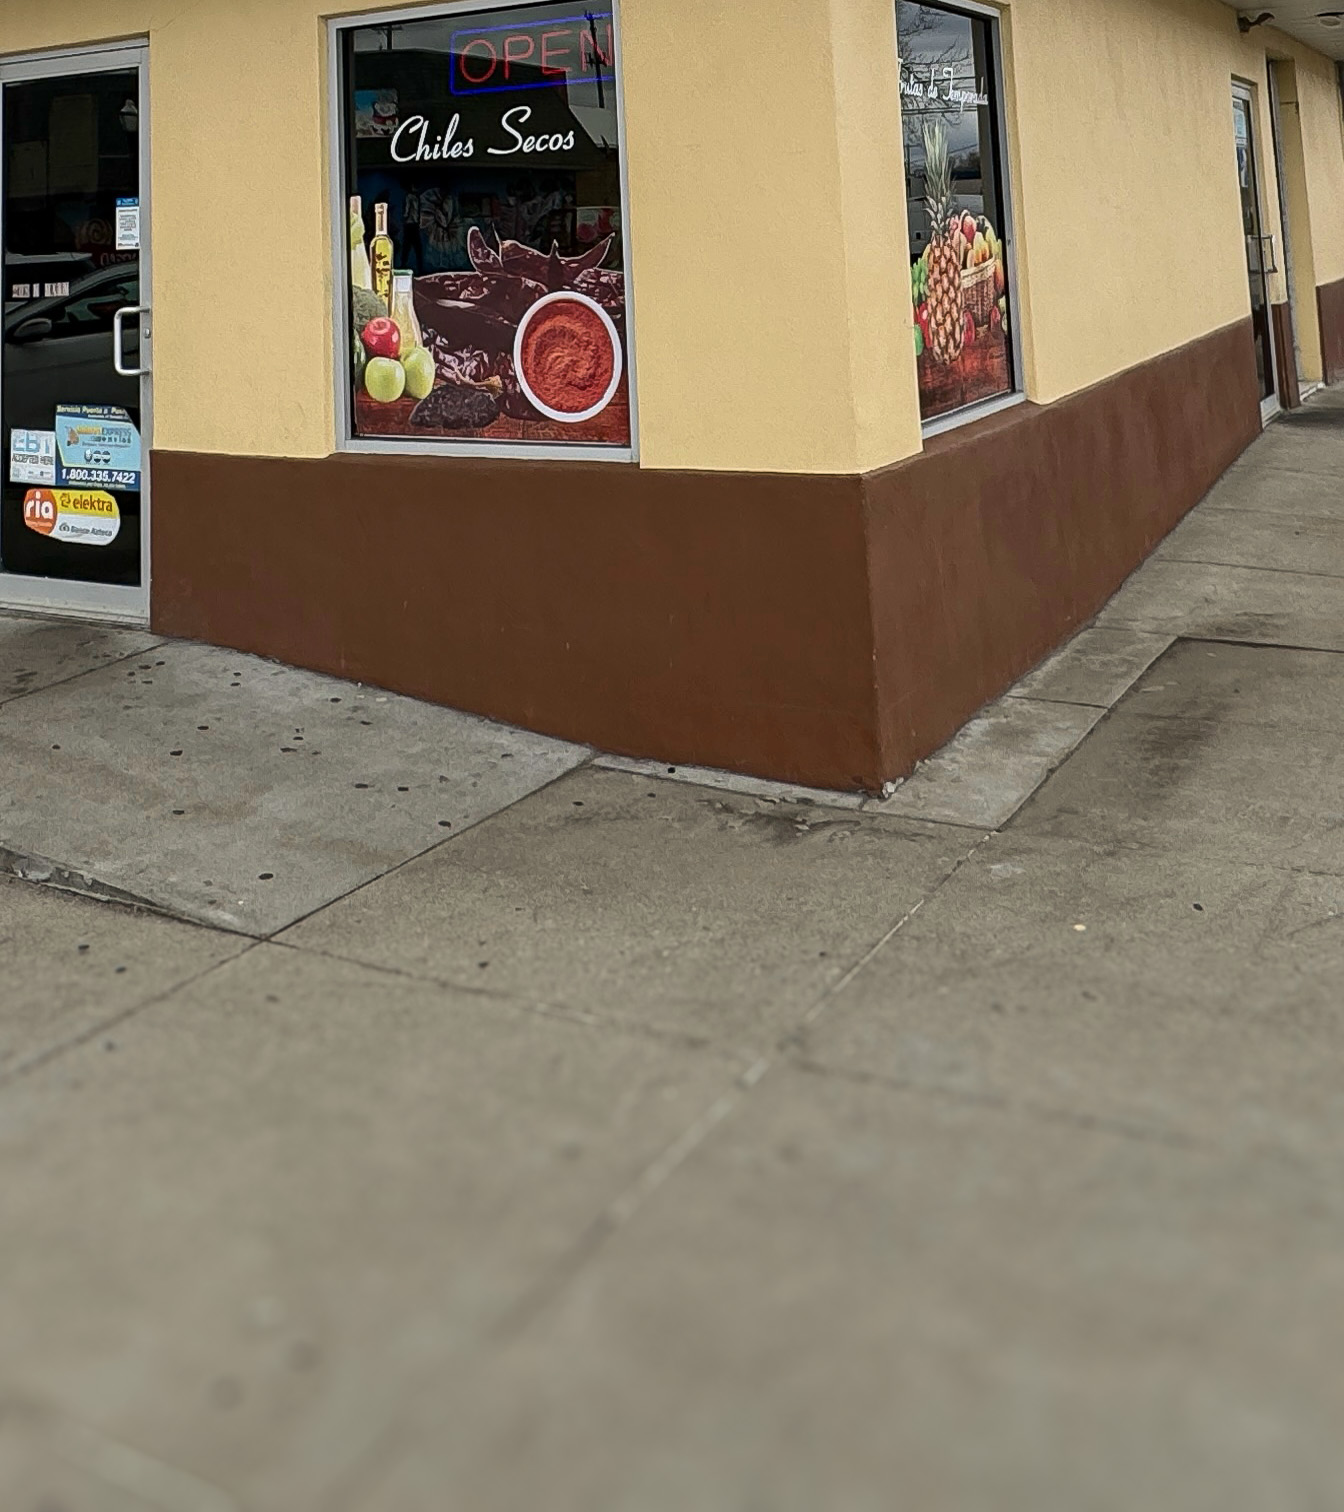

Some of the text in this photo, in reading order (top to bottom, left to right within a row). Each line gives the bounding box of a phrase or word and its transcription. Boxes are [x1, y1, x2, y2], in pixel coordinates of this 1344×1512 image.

[459, 23, 613, 83] OPEN
[390, 104, 576, 163] Chiles Secos
[25, 491, 113, 520] ria elektra
